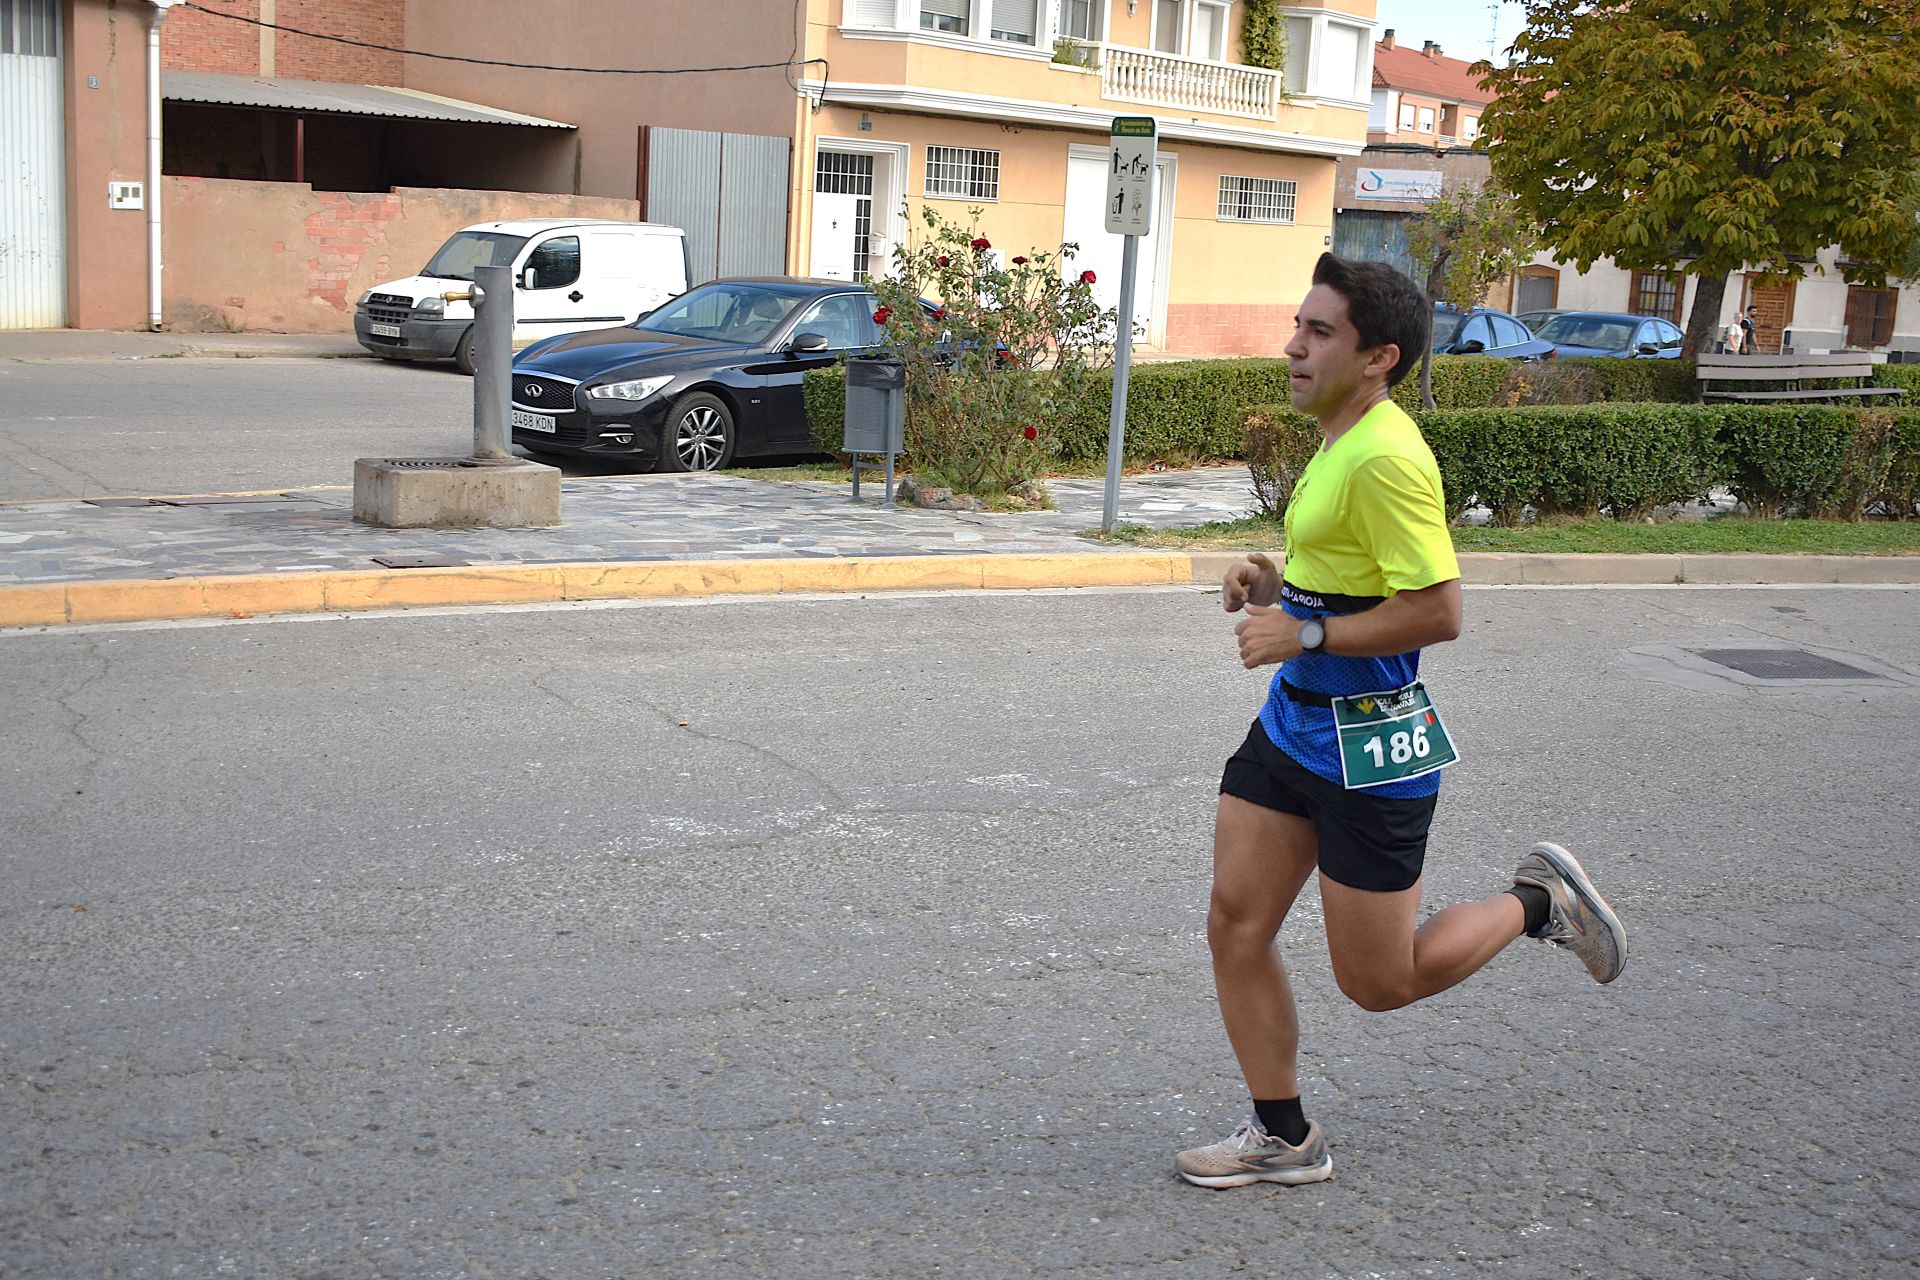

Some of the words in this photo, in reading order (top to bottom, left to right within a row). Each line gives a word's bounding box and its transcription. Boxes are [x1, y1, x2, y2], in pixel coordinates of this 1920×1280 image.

[512, 412, 533, 427] 3468
[536, 416, 553, 430] KDN
[1363, 725, 1430, 768] 186
